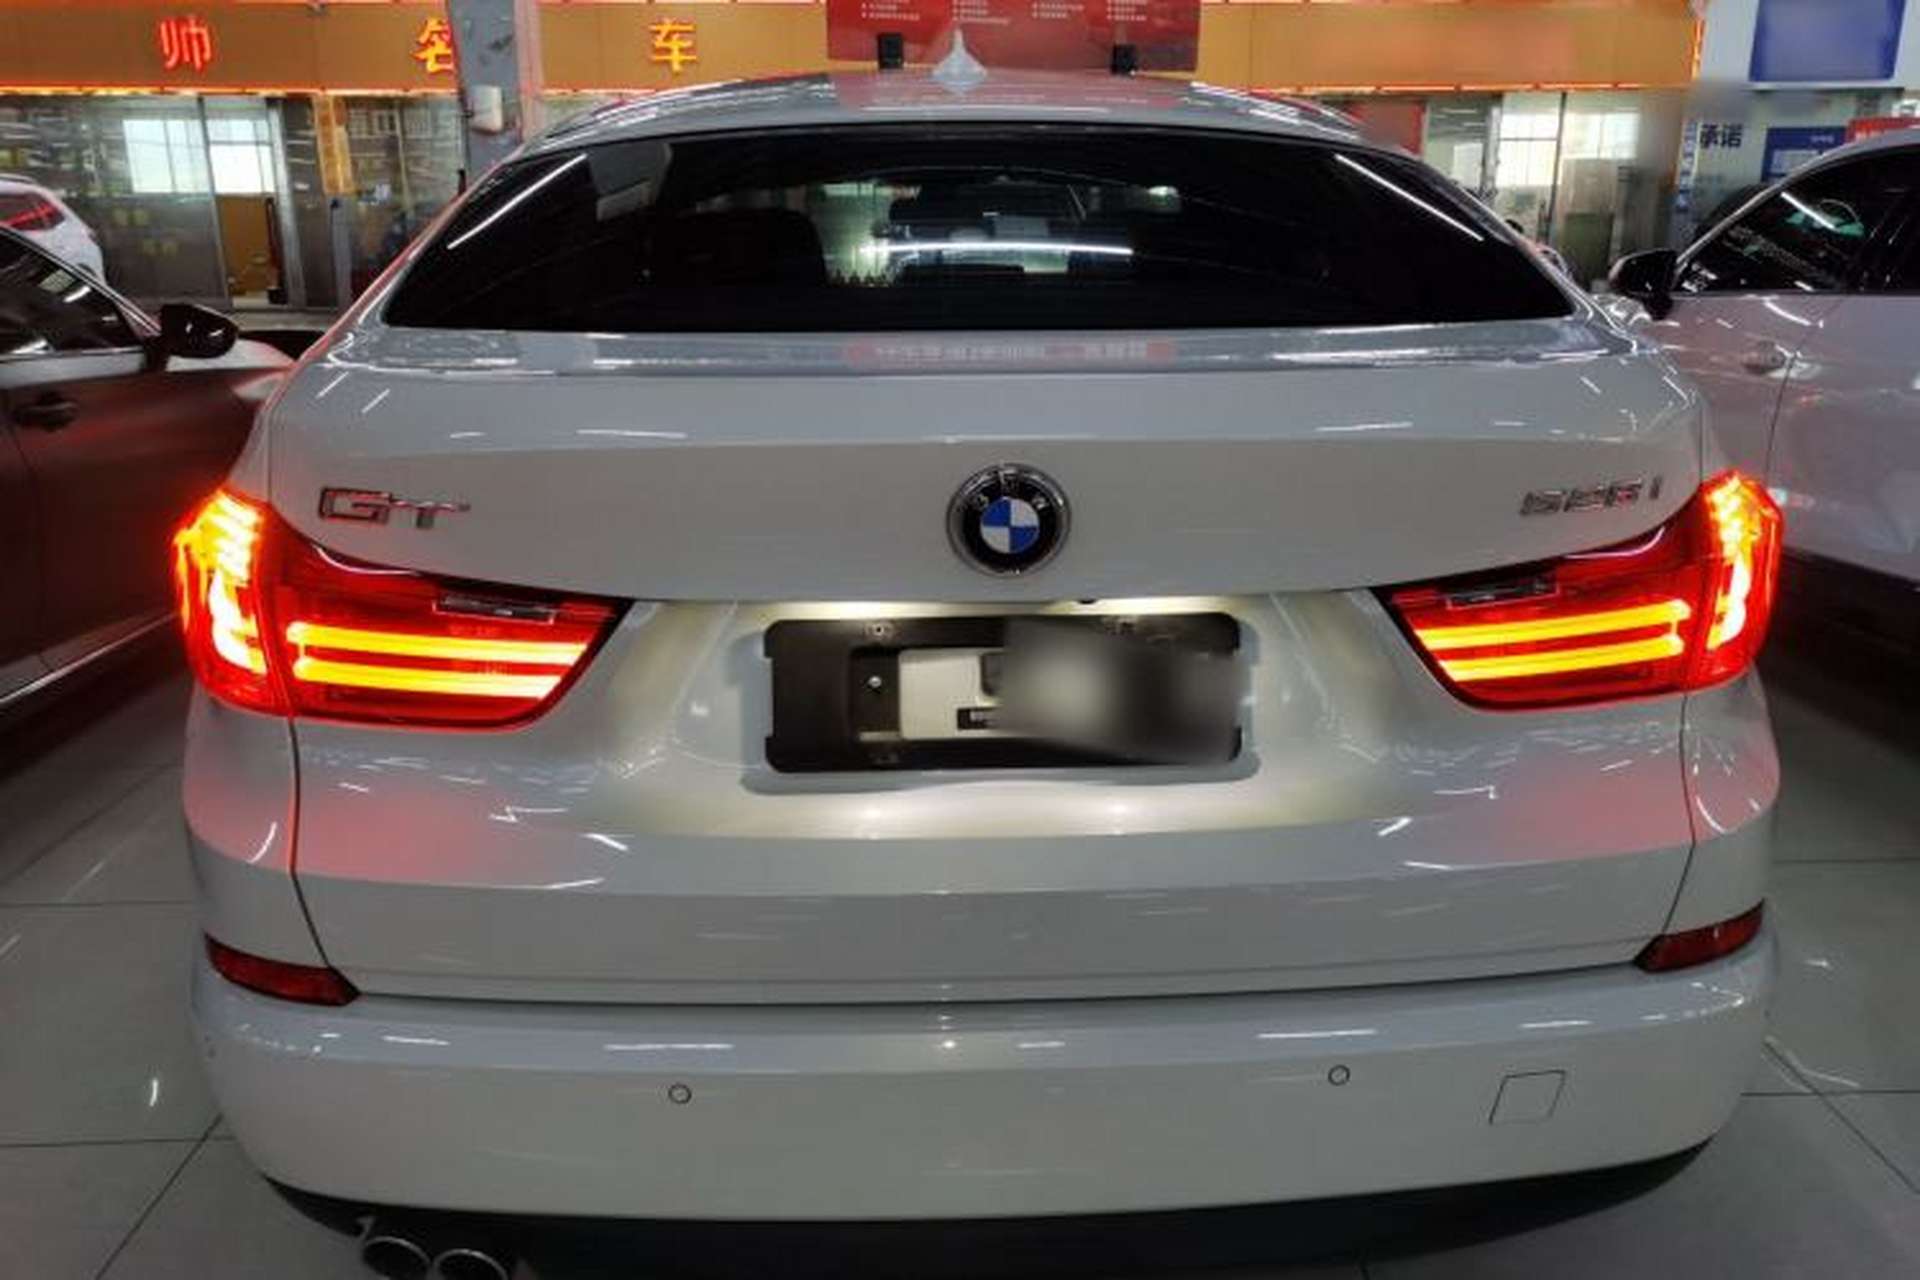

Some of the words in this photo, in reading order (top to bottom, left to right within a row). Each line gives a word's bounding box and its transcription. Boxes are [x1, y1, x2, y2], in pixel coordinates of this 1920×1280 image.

[160, 18, 212, 69] 帅
[648, 19, 697, 72] 车
[1699, 123, 1743, 149] 承诺
[318, 486, 471, 530] GT
